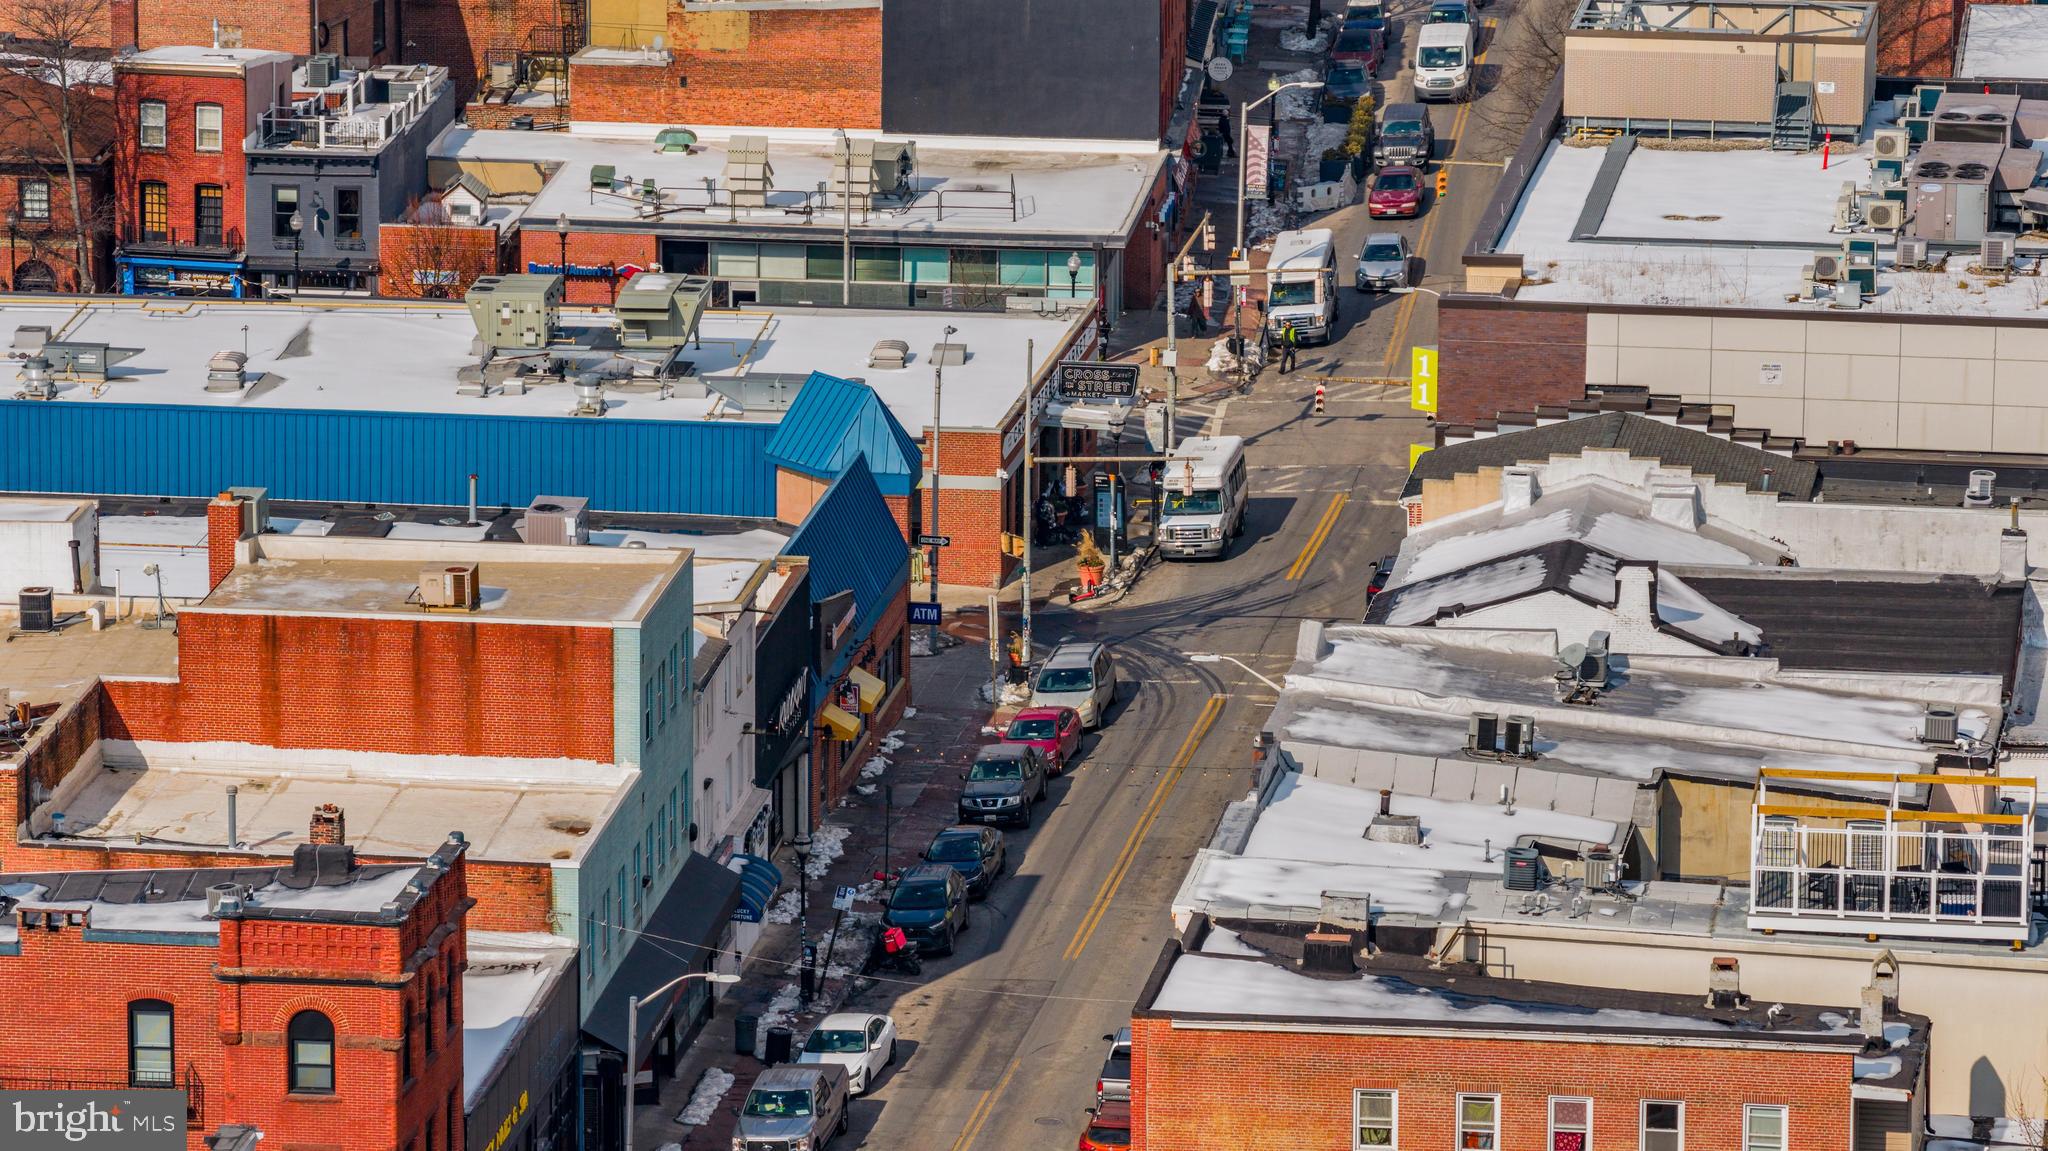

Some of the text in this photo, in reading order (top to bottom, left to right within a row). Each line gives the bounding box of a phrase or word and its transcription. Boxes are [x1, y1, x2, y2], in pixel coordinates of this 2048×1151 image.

[528, 261, 552, 274] Bank
[568, 263, 614, 277] America
[1064, 368, 1110, 381] CROSS
[1077, 380, 1131, 393] STREET
[913, 607, 938, 620] ATM
